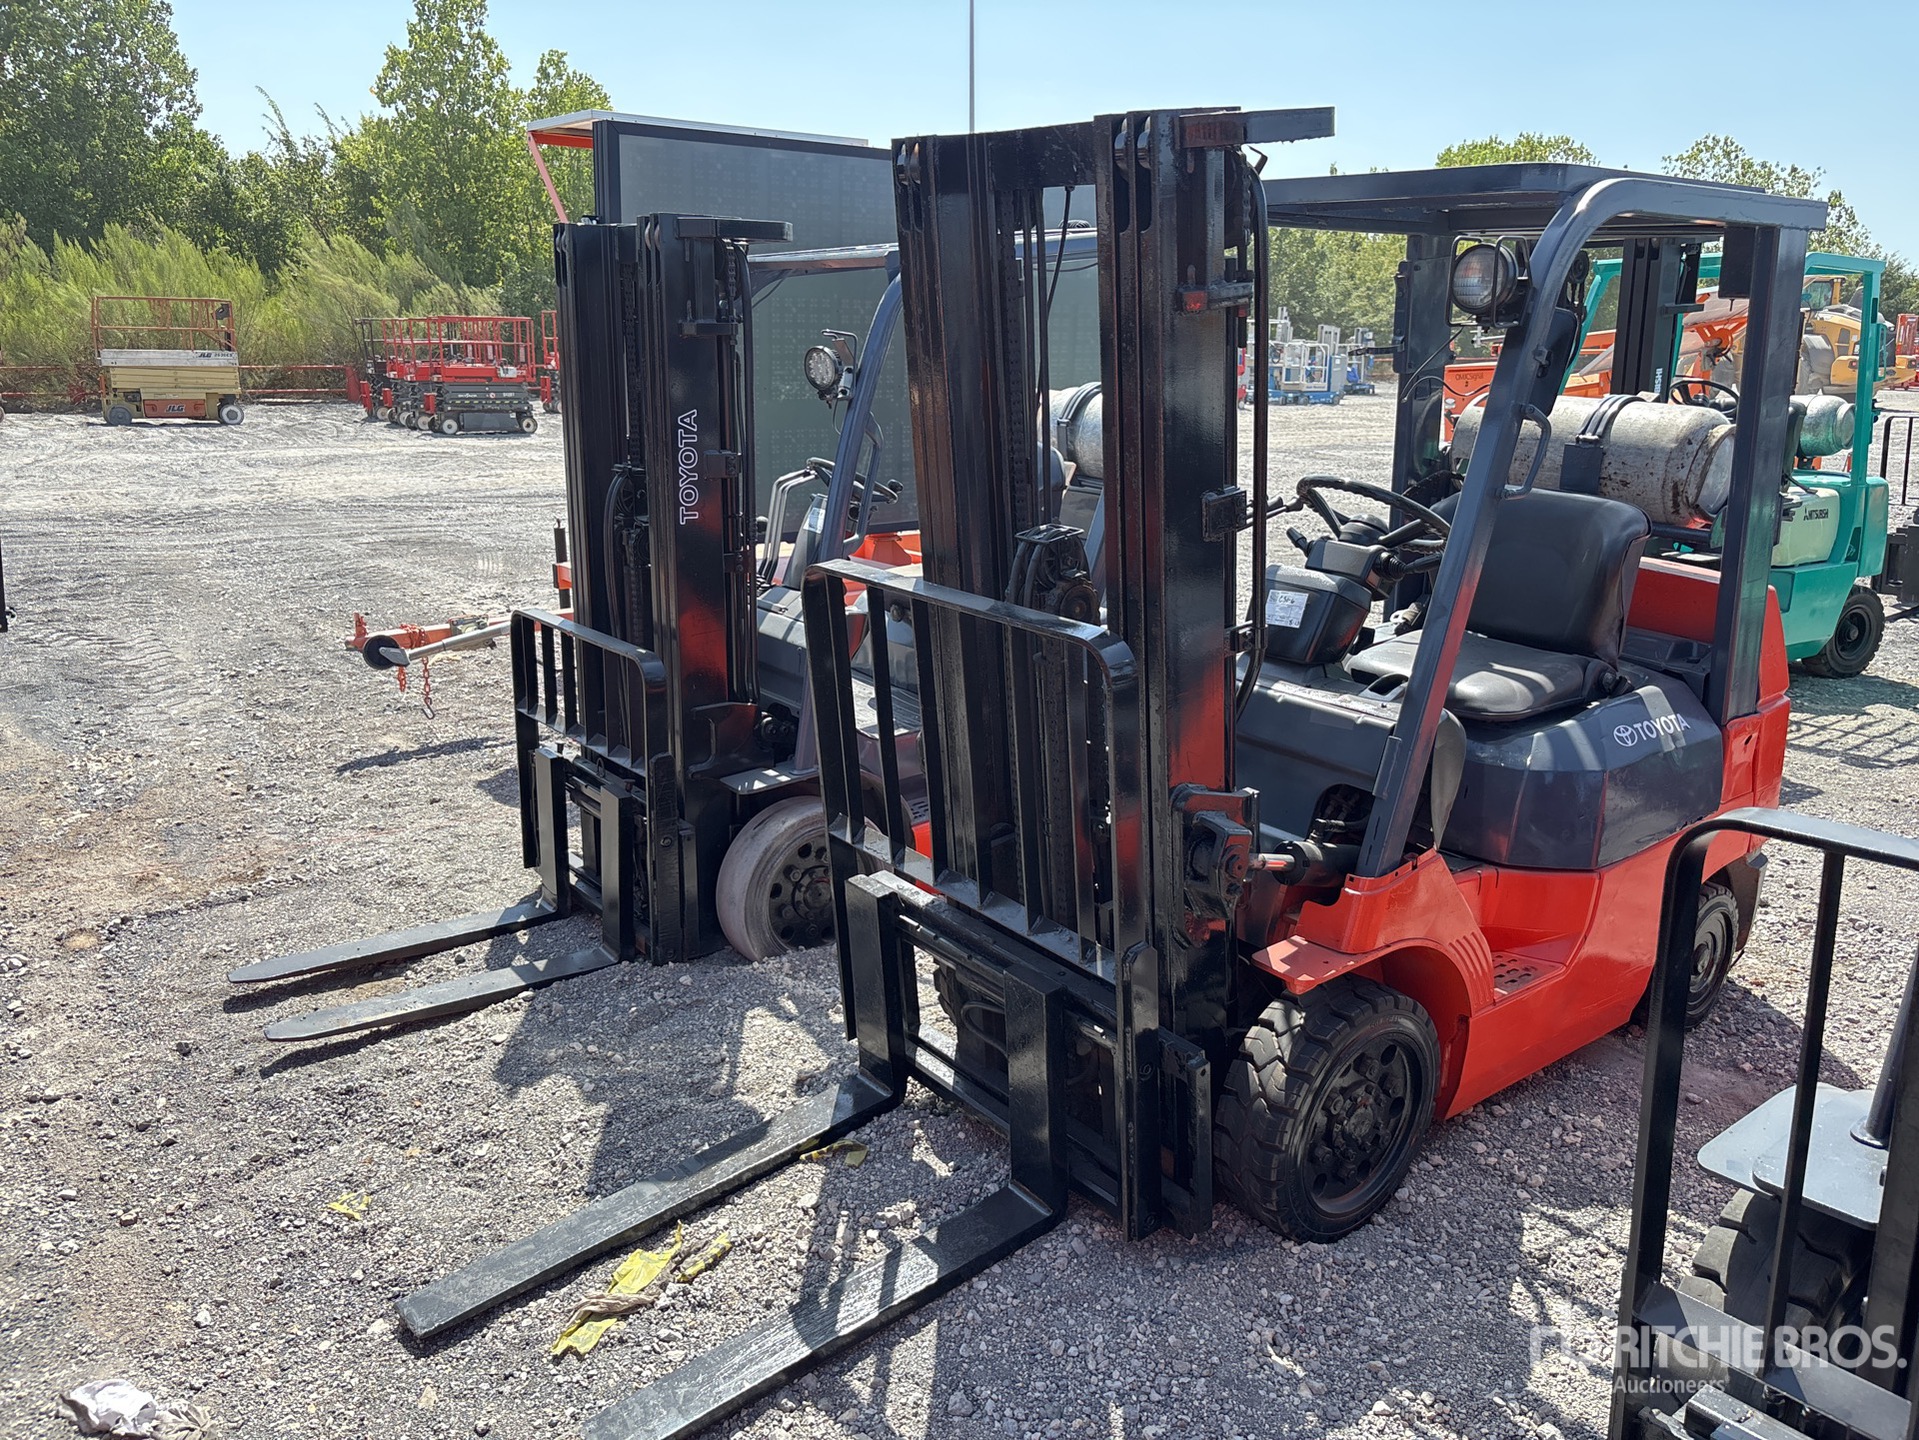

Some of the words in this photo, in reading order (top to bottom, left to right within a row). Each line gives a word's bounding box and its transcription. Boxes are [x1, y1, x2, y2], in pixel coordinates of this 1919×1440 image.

[166, 404, 185, 413] JLG
[678, 409, 699, 525] TOYOTA
[1633, 713, 1691, 740] TOYOTA
